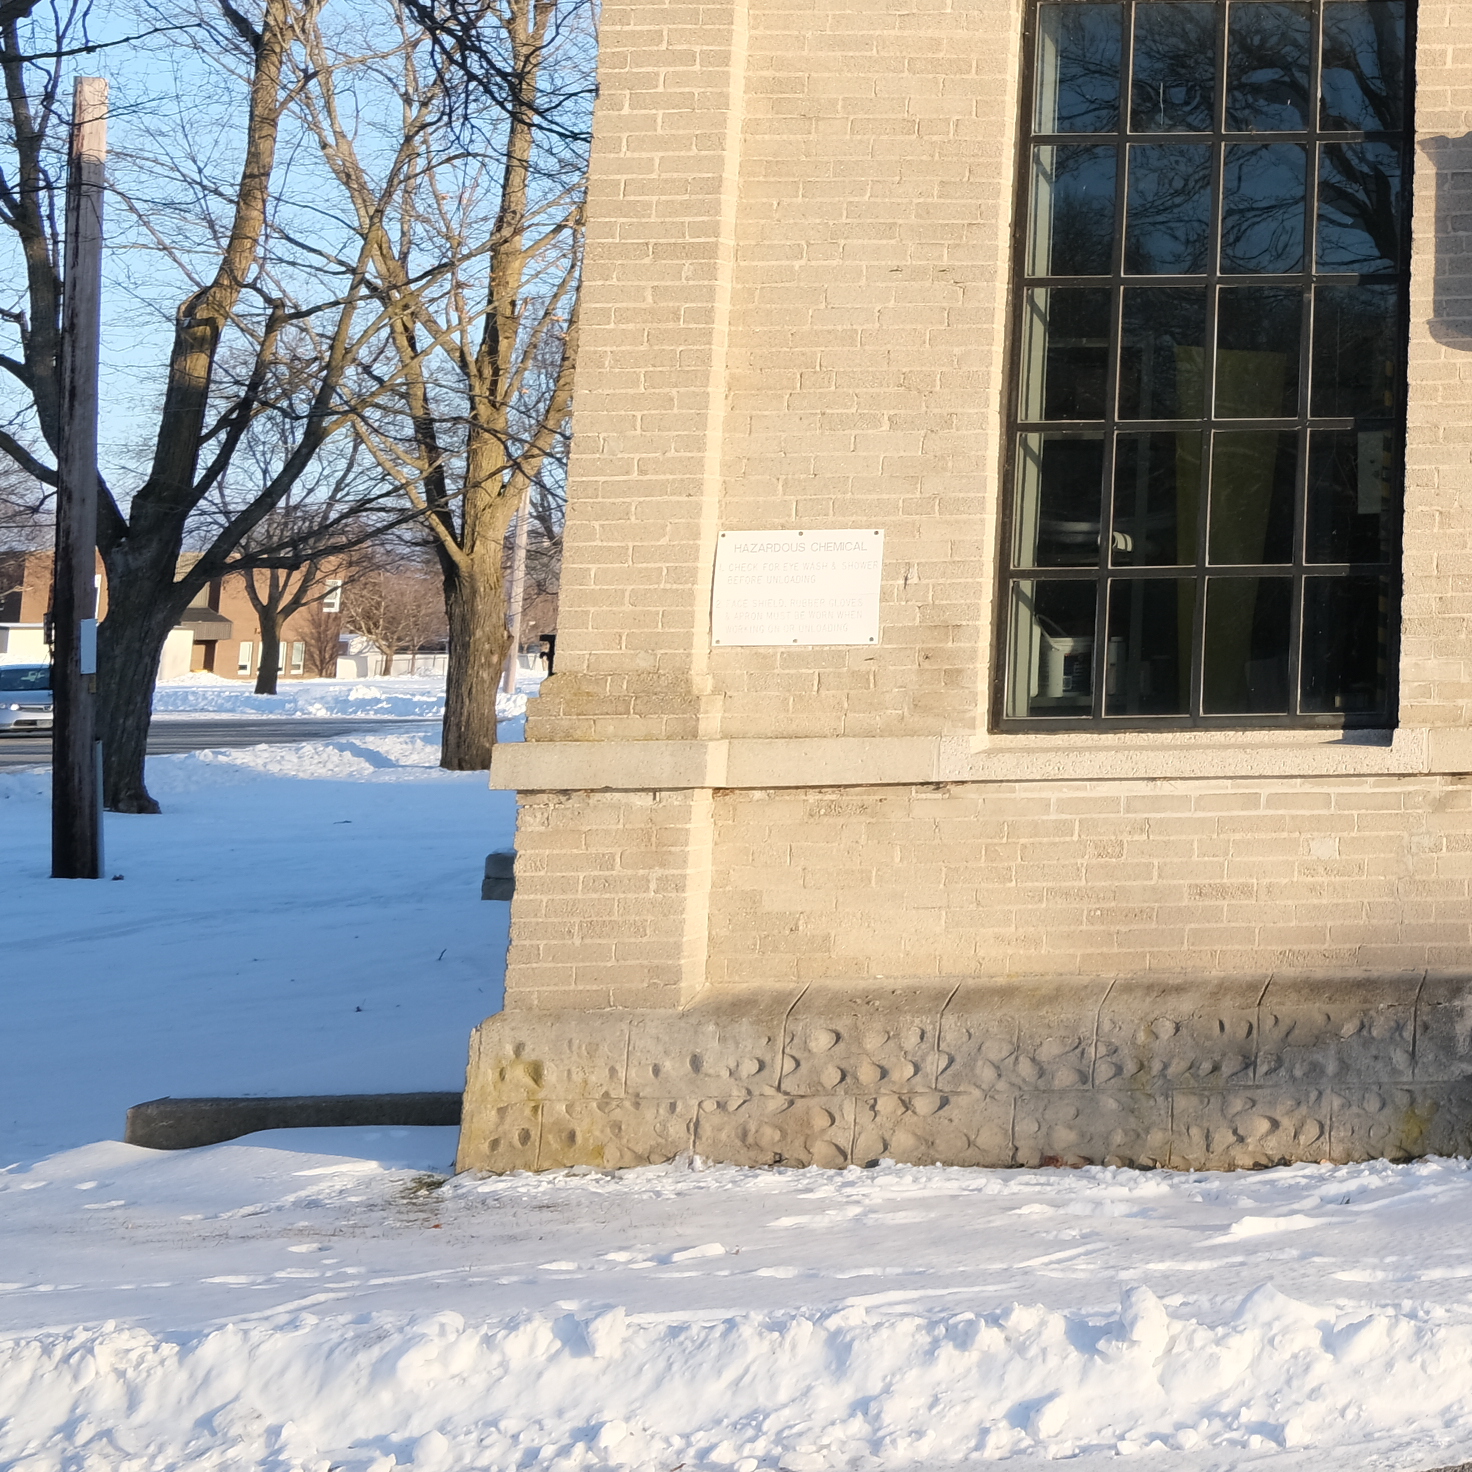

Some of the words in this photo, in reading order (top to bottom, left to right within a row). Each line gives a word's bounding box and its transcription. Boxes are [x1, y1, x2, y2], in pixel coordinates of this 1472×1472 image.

[734, 543, 806, 553] HAZARDOUS
[810, 542, 867, 552] CHEMICAL
[728, 563, 758, 572] CHECK
[763, 562, 780, 572] FOR
[783, 562, 800, 572] EYE
[803, 561, 827, 571] WASH
[841, 560, 878, 570] SHOWER
[727, 575, 763, 585] BEFORE
[766, 574, 816, 584] UNLOADING
[726, 599, 748, 608] FACE
[790, 598, 825, 608] RUBBER
[828, 598, 863, 608] GLOVES
[734, 611, 763, 621] APRON
[766, 611, 791, 620] MUST
[794, 610, 805, 620] BE
[808, 610, 834, 620] WORN
[837, 610, 862, 619] WHEN
[726, 624, 765, 634] WORKING
[798, 623, 848, 633] UNLOADING
